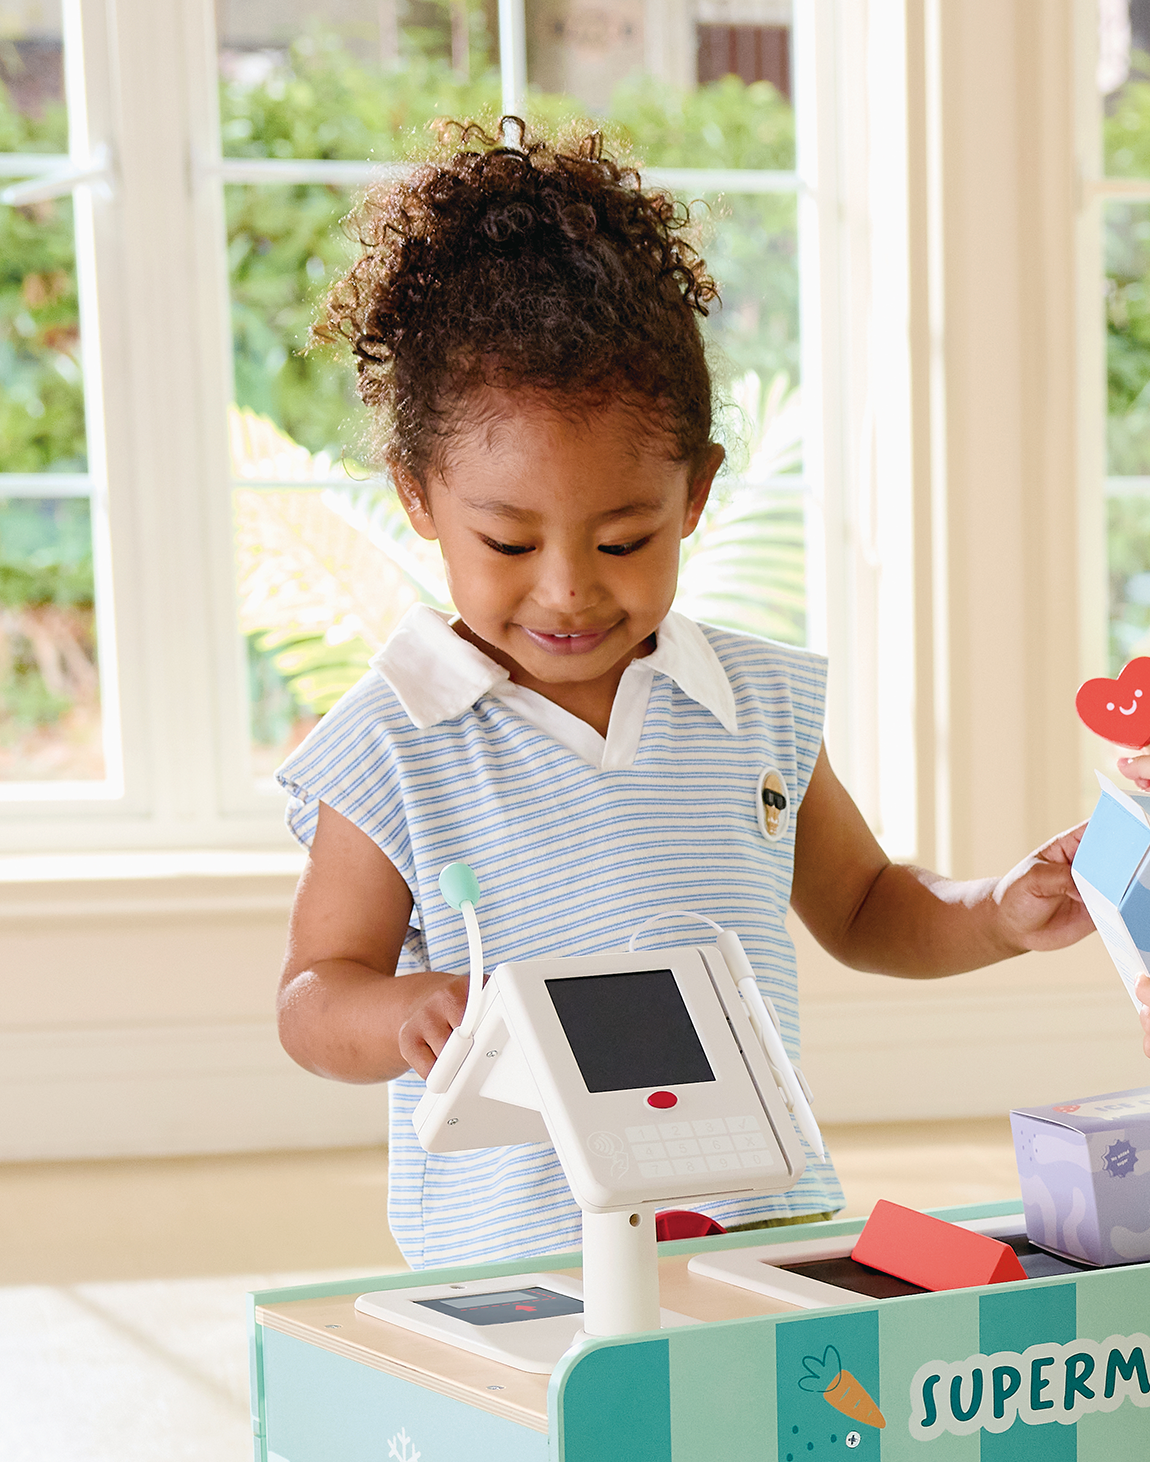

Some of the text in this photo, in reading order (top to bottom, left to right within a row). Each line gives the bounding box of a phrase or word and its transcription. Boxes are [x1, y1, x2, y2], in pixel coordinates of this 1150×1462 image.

[671, 1126, 681, 1136] 2
[705, 1122, 714, 1132] 3
[678, 1143, 687, 1153] 5
[712, 1140, 721, 1150] 6
[651, 1164, 659, 1175] 7
[686, 1162, 695, 1172] 8
[719, 1158, 728, 1168] 9
